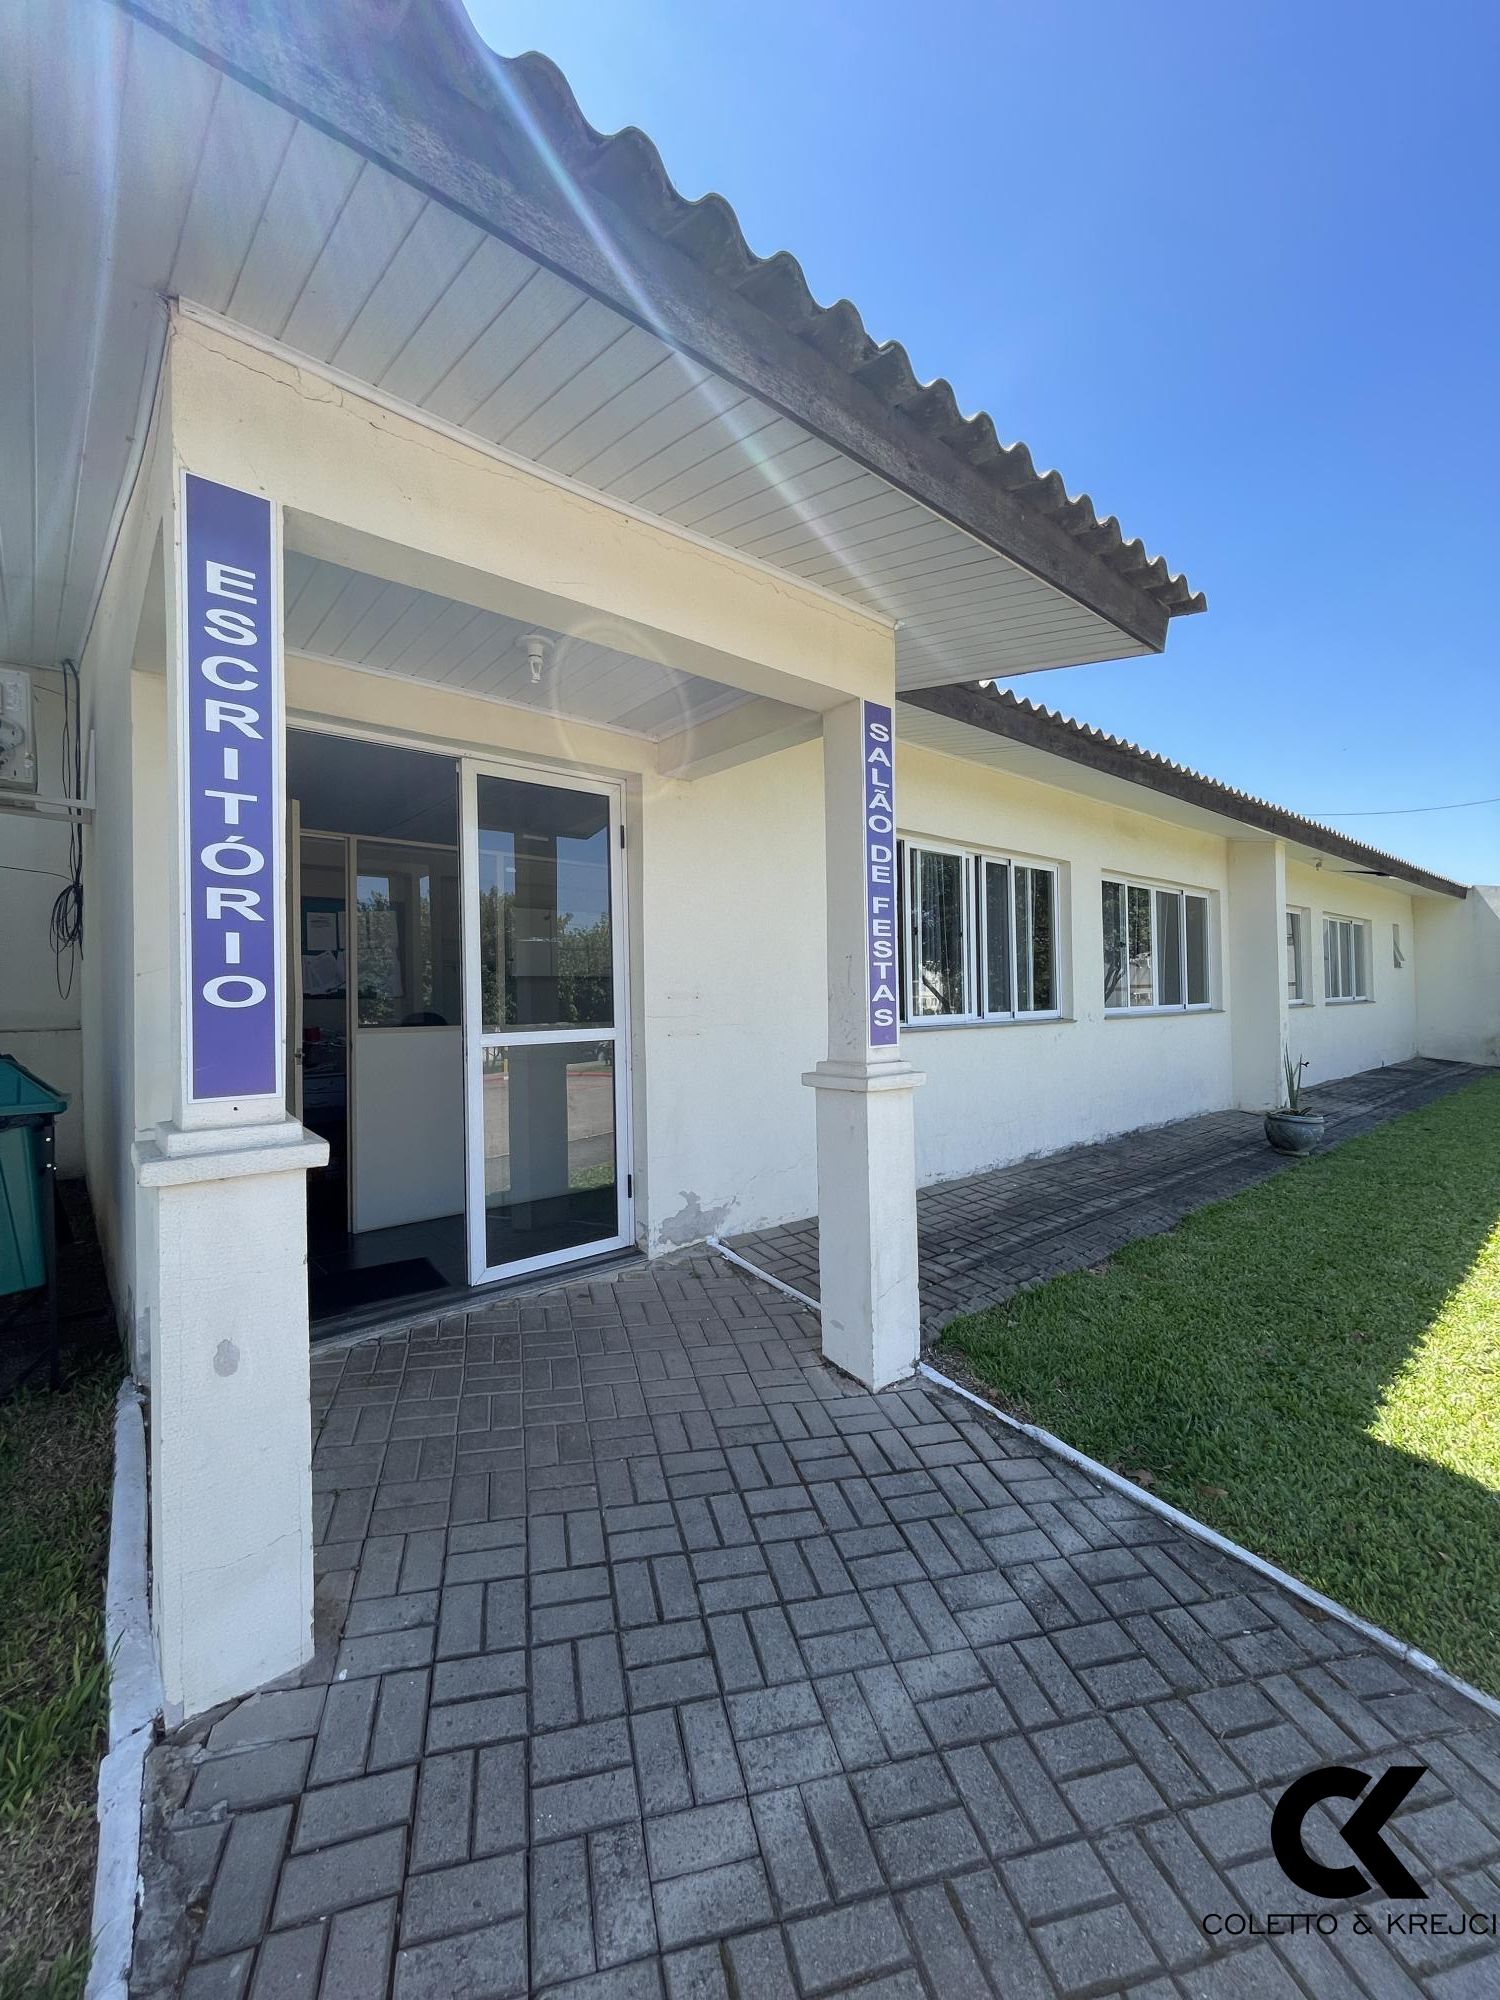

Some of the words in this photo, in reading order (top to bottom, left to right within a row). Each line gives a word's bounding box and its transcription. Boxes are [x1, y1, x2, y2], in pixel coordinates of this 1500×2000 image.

[200, 560, 267, 1008] ESCRITÓRIO
[868, 723, 891, 834] SALÃO
[871, 844, 892, 884] DE
[872, 896, 895, 1027] FESTAS
